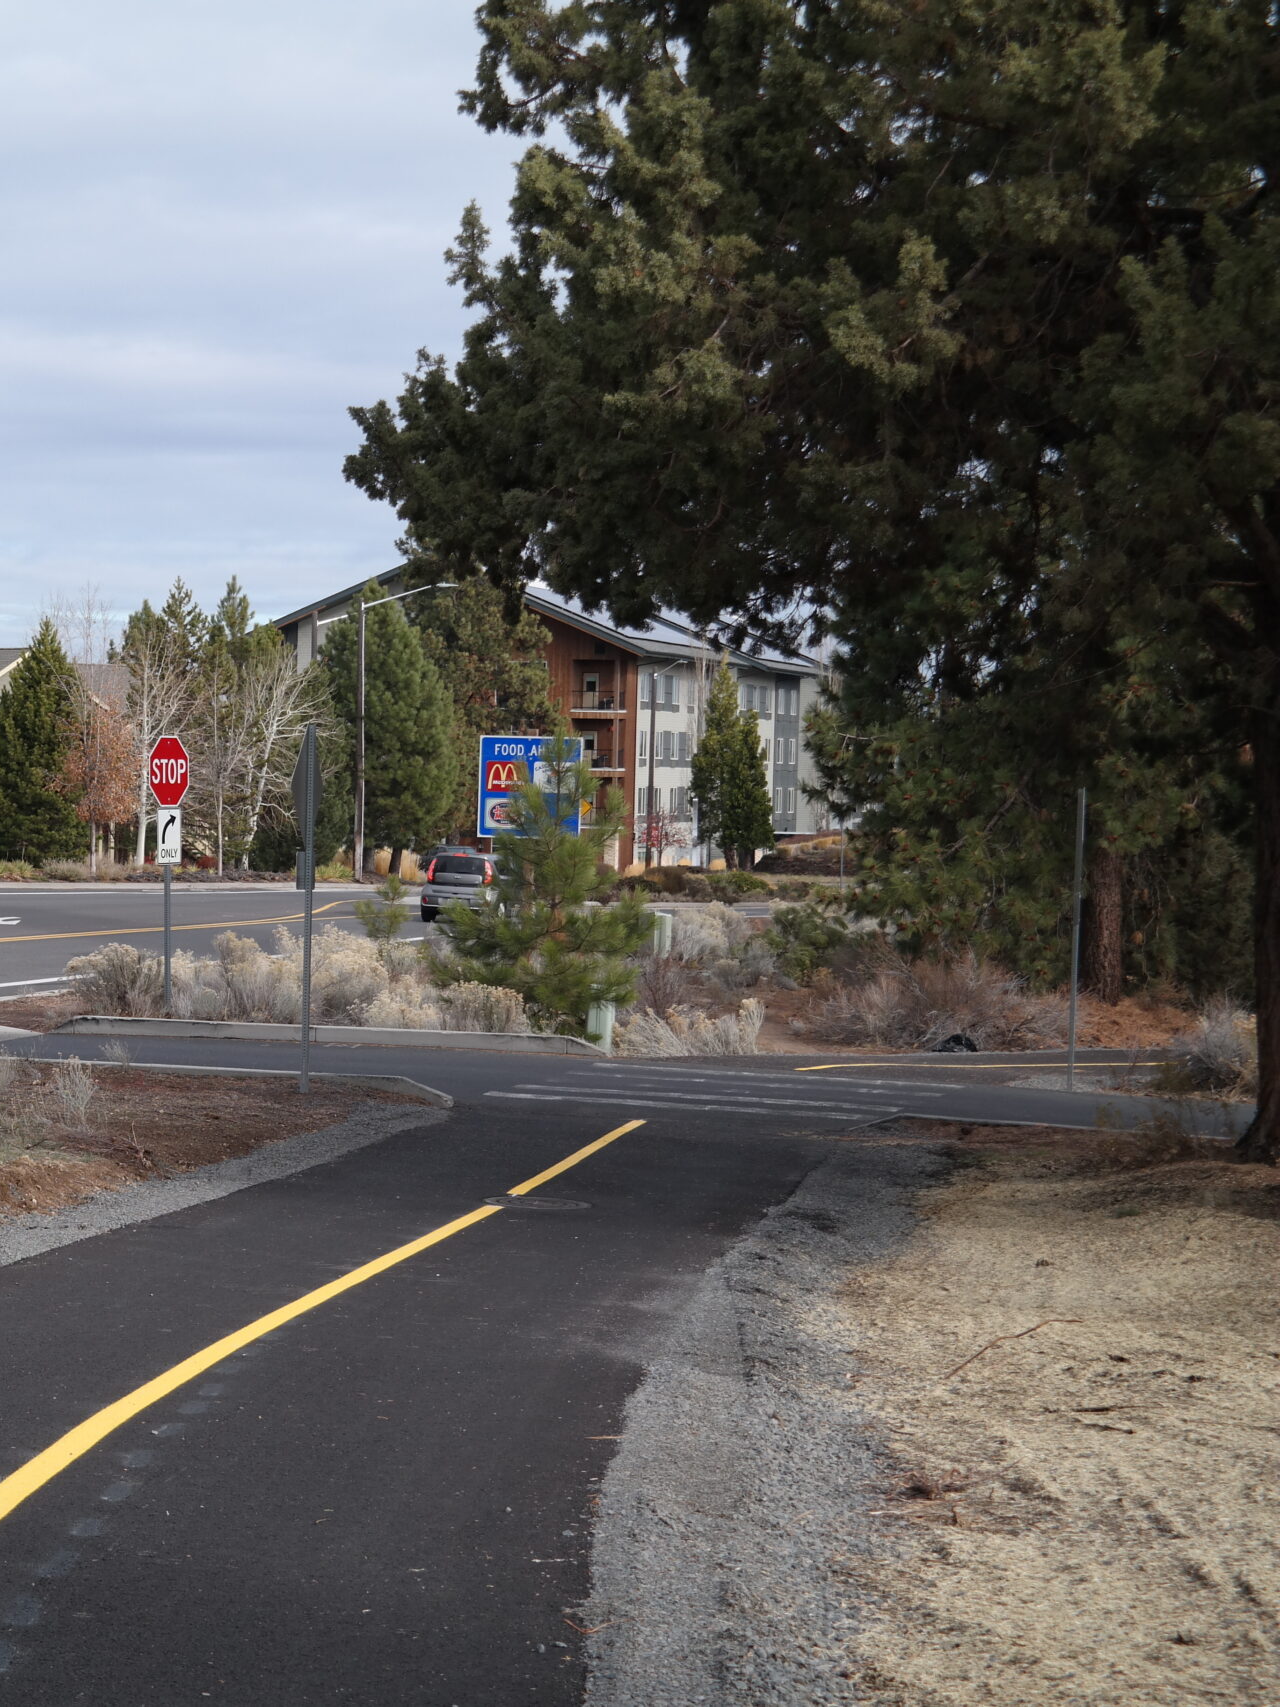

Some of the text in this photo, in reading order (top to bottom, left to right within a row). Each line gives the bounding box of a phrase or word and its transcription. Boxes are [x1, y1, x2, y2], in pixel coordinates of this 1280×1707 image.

[494, 744, 524, 756] FOOD
[152, 758, 186, 784] STOP
[160, 848, 178, 859] ONLY
